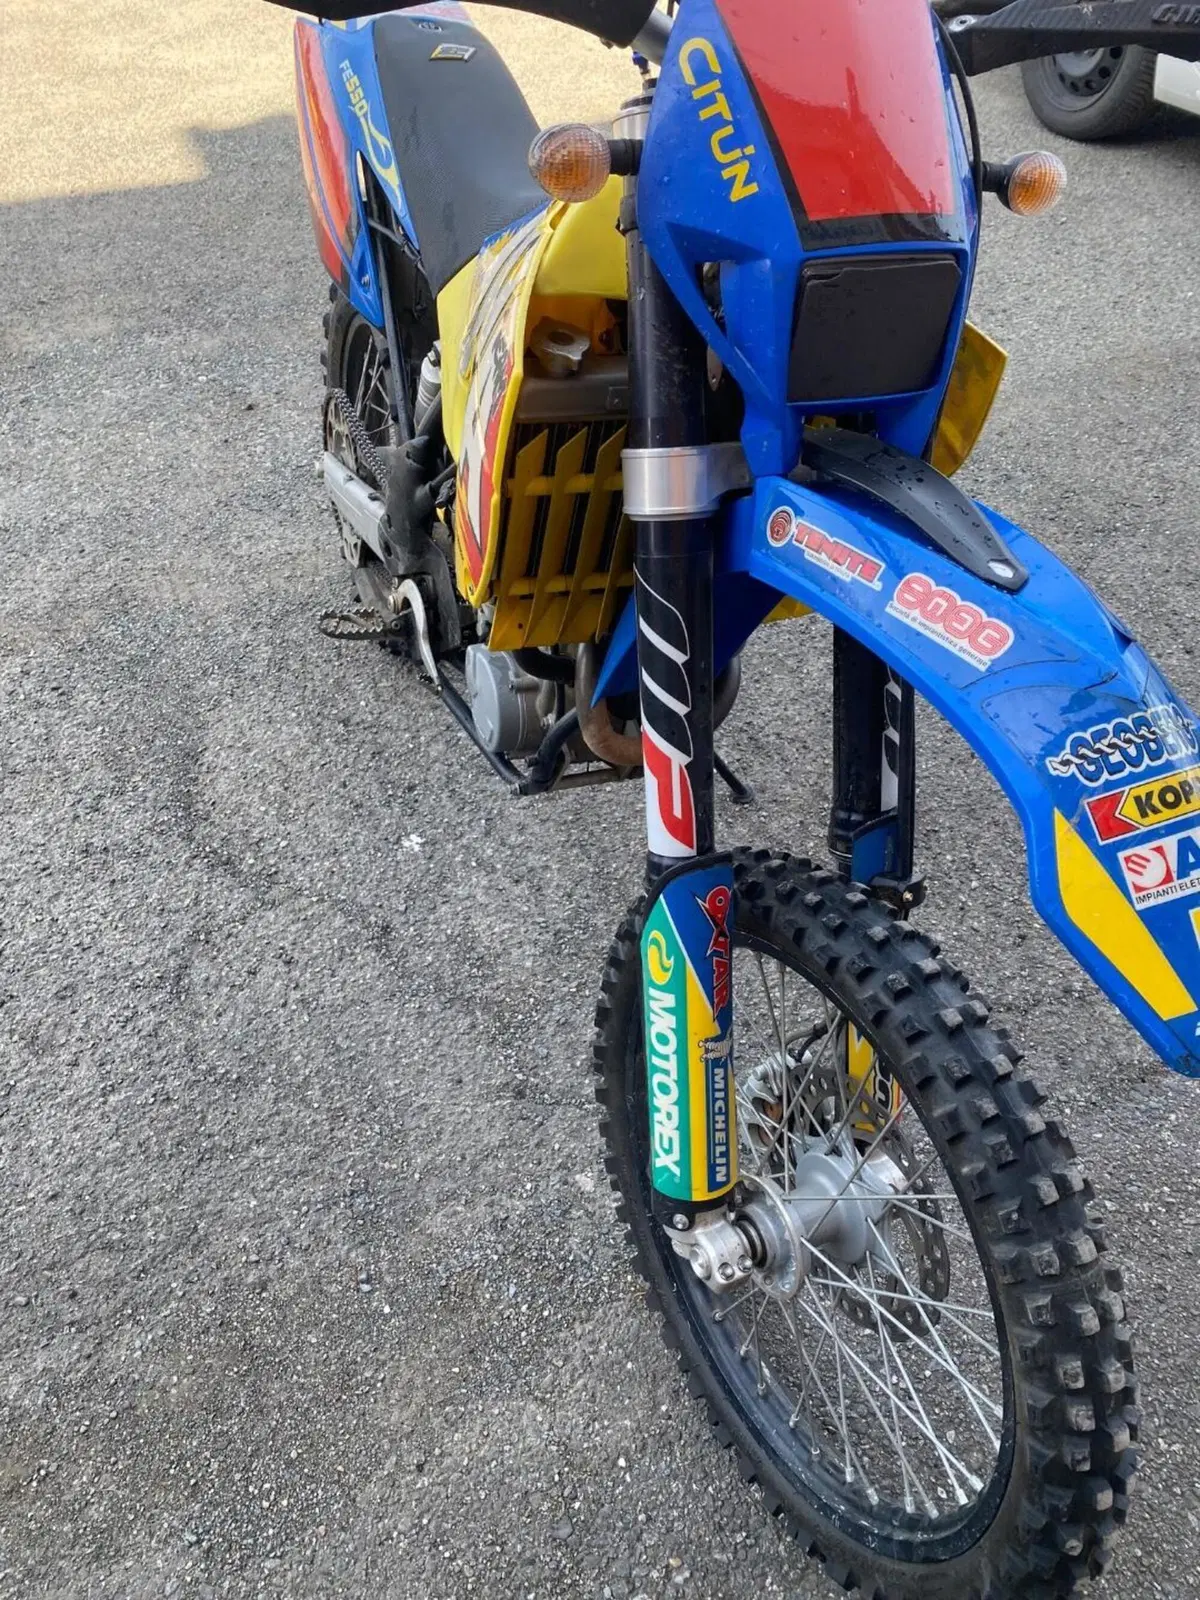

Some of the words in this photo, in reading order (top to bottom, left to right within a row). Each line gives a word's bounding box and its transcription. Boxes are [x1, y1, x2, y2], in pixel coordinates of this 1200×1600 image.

[1135, 885, 1178, 905] IMPIANTI
[647, 986, 682, 1177] MOTOREX
[713, 1067, 730, 1183] MICHELIN
